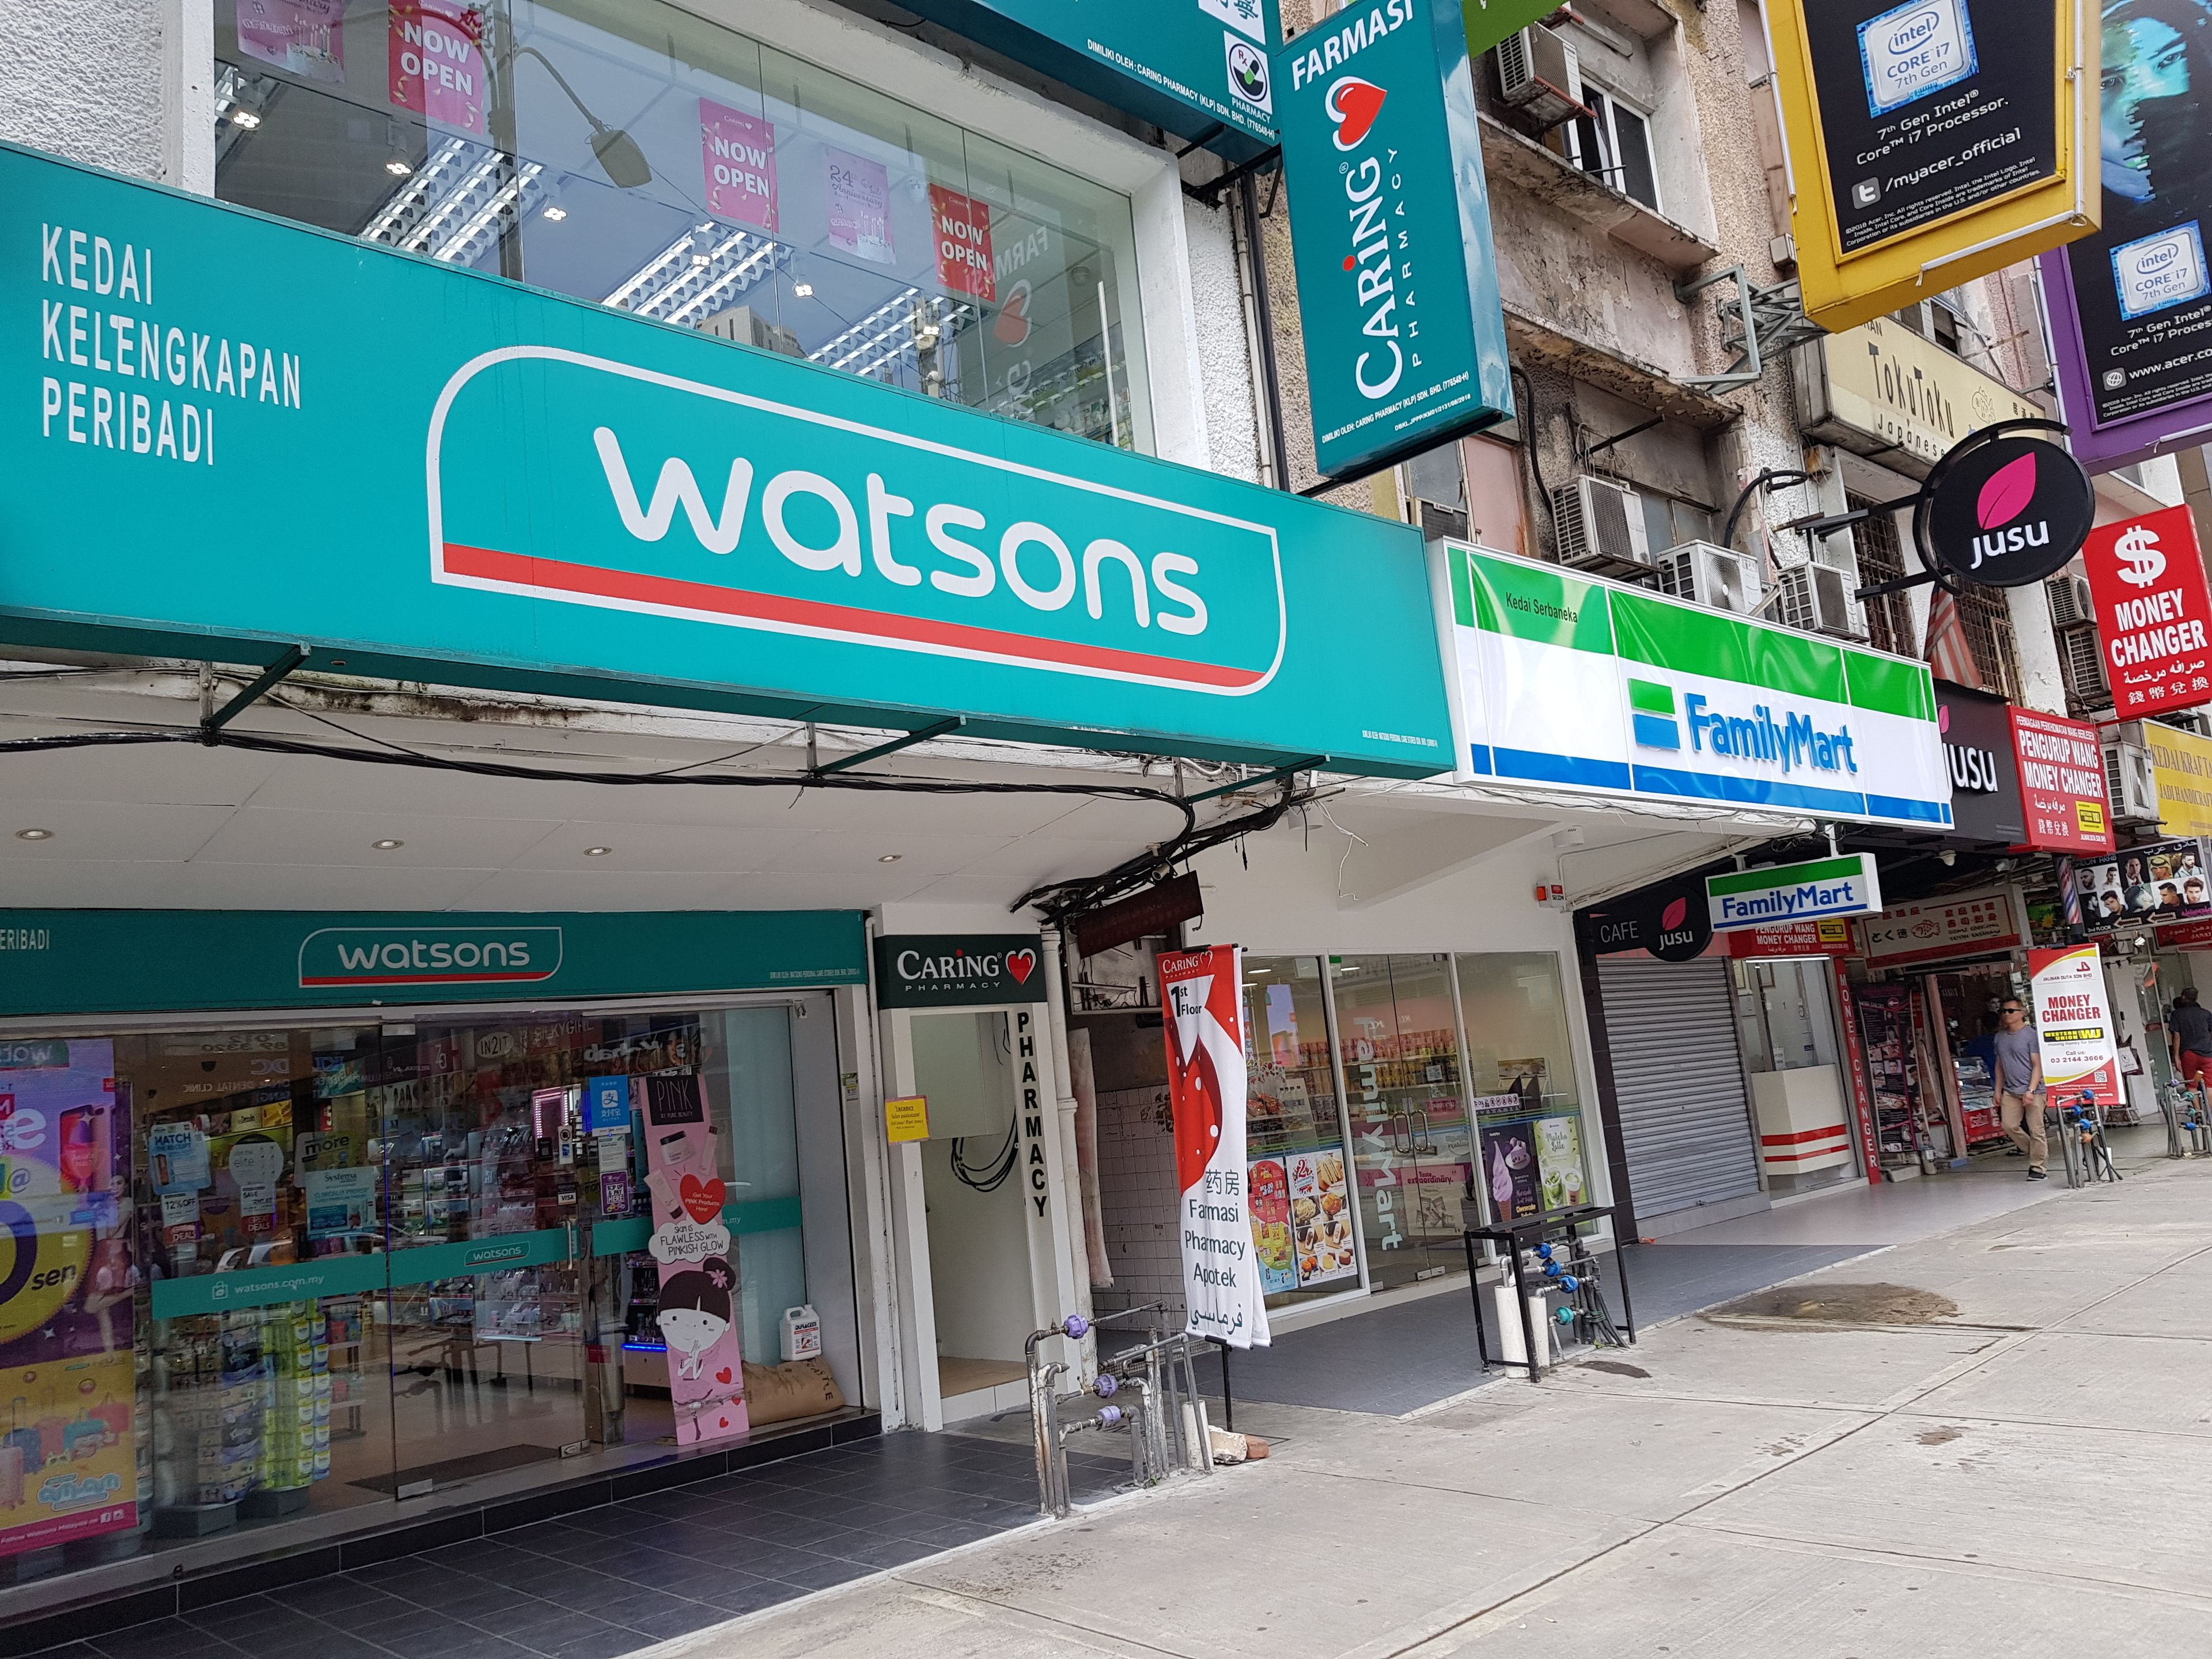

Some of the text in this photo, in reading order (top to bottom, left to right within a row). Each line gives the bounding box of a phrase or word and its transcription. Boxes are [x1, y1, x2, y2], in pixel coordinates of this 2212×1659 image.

[404, 21, 469, 63] NOW
[1290, 0, 1415, 92] FARMASI
[1894, 18, 1932, 47] intel
[1936, 42, 1950, 58] i7
[401, 51, 473, 96] OPEN
[1087, 39, 1115, 60] DIMILIKI
[1137, 63, 1162, 84] CARING
[1163, 77, 1198, 101] PHARMACY
[1199, 94, 1215, 111] (KLP)
[1217, 104, 1230, 118] SDN.
[1232, 112, 1245, 125] BHD.
[1895, 61, 1948, 89] 7th Gen
[1232, 97, 1271, 123] PHARMACY
[1909, 130, 1922, 145] i7
[1926, 97, 2009, 137] Processor.
[1877, 126, 1896, 141] 7th
[1900, 112, 1930, 131] Gen
[714, 137, 766, 169] NOW
[1885, 127, 2021, 192] /myacer_official
[714, 164, 769, 198] OPEN
[1967, 177, 2003, 195] trademarks
[832, 184, 882, 209] Anniversary
[1846, 170, 2041, 247] Corporation subsidiaries and/or countries.
[942, 215, 983, 245] NOW
[42, 223, 153, 305] KEDAI
[941, 241, 987, 271] OPEN
[1387, 147, 1422, 368] PHARMACY
[2141, 248, 2173, 268] intel
[2176, 268, 2187, 279] i7
[2142, 282, 2186, 300] 7th Gen
[2127, 327, 2143, 339] 7th
[2146, 320, 2171, 333] Gen
[2154, 333, 2164, 343] i7
[42, 299, 301, 410] KELENGKAPAN
[42, 376, 214, 465] PERIBADI
[1321, 429, 1340, 444] DIMILIKI
[1340, 423, 1355, 435] OLEH:
[1355, 415, 1374, 428] CARING
[1374, 401, 1402, 420] PHARMACY
[1403, 394, 1416, 408] (KLP)
[1416, 388, 1429, 401] SDN.
[1430, 383, 1442, 396] BHD.
[593, 426, 1209, 637] watsons
[1506, 590, 1578, 624] Kedai Serbaneka
[2115, 588, 2183, 632] MONEY
[2111, 620, 2208, 668] CHANGER
[1684, 692, 1859, 774] FamilyMart
[2018, 729, 2099, 768] PENGURUP WANG
[2150, 744, 2203, 777] KEDAI KRAF
[2024, 761, 2104, 798] MONEY CHANGER
[2160, 783, 2174, 801] JADI
[2099, 854, 2117, 863] ARAB
[1722, 882, 1854, 918] FamilyMart
[1600, 921, 1639, 943] CAFE
[1756, 923, 1793, 933] PENGURUP
[1794, 924, 1815, 933] WANG
[1757, 934, 1817, 945] MONEY CHANGER
[338, 939, 529, 969] watsons
[906, 981, 1001, 991] PHARMACY
[1166, 969, 1199, 979] PHARMACY
[1181, 1004, 1202, 1015] Floor
[2042, 1007, 2101, 1022] CHANGER
[2048, 994, 2090, 1009] MONEY
[1839, 974, 1878, 1168] MONEY CHANGER
[657, 1080, 692, 1112] PINK
[1018, 1011, 1046, 1218] PHARMACY
[154, 1132, 191, 1145] MATCH
[305, 1136, 349, 1154] more
[1546, 1131, 1567, 1142] Matcha
[1551, 1141, 1566, 1152] Latte
[325, 1173, 357, 1181] Systema
[1205, 1168, 1240, 1197] 药房
[560, 1194, 574, 1202] VISA
[1189, 1197, 1239, 1225] Farmasi
[248, 1222, 270, 1232] DEALS
[660, 1232, 704, 1246] FLAWLESS
[473, 1244, 522, 1262] watsons
[668, 1240, 724, 1256] PINKISH GLOW
[1184, 1229, 1246, 1261] Pharmacy
[31, 1264, 77, 1291] sen
[235, 1274, 325, 1295] watsons.com.my
[1192, 1261, 1236, 1289] Apotek
